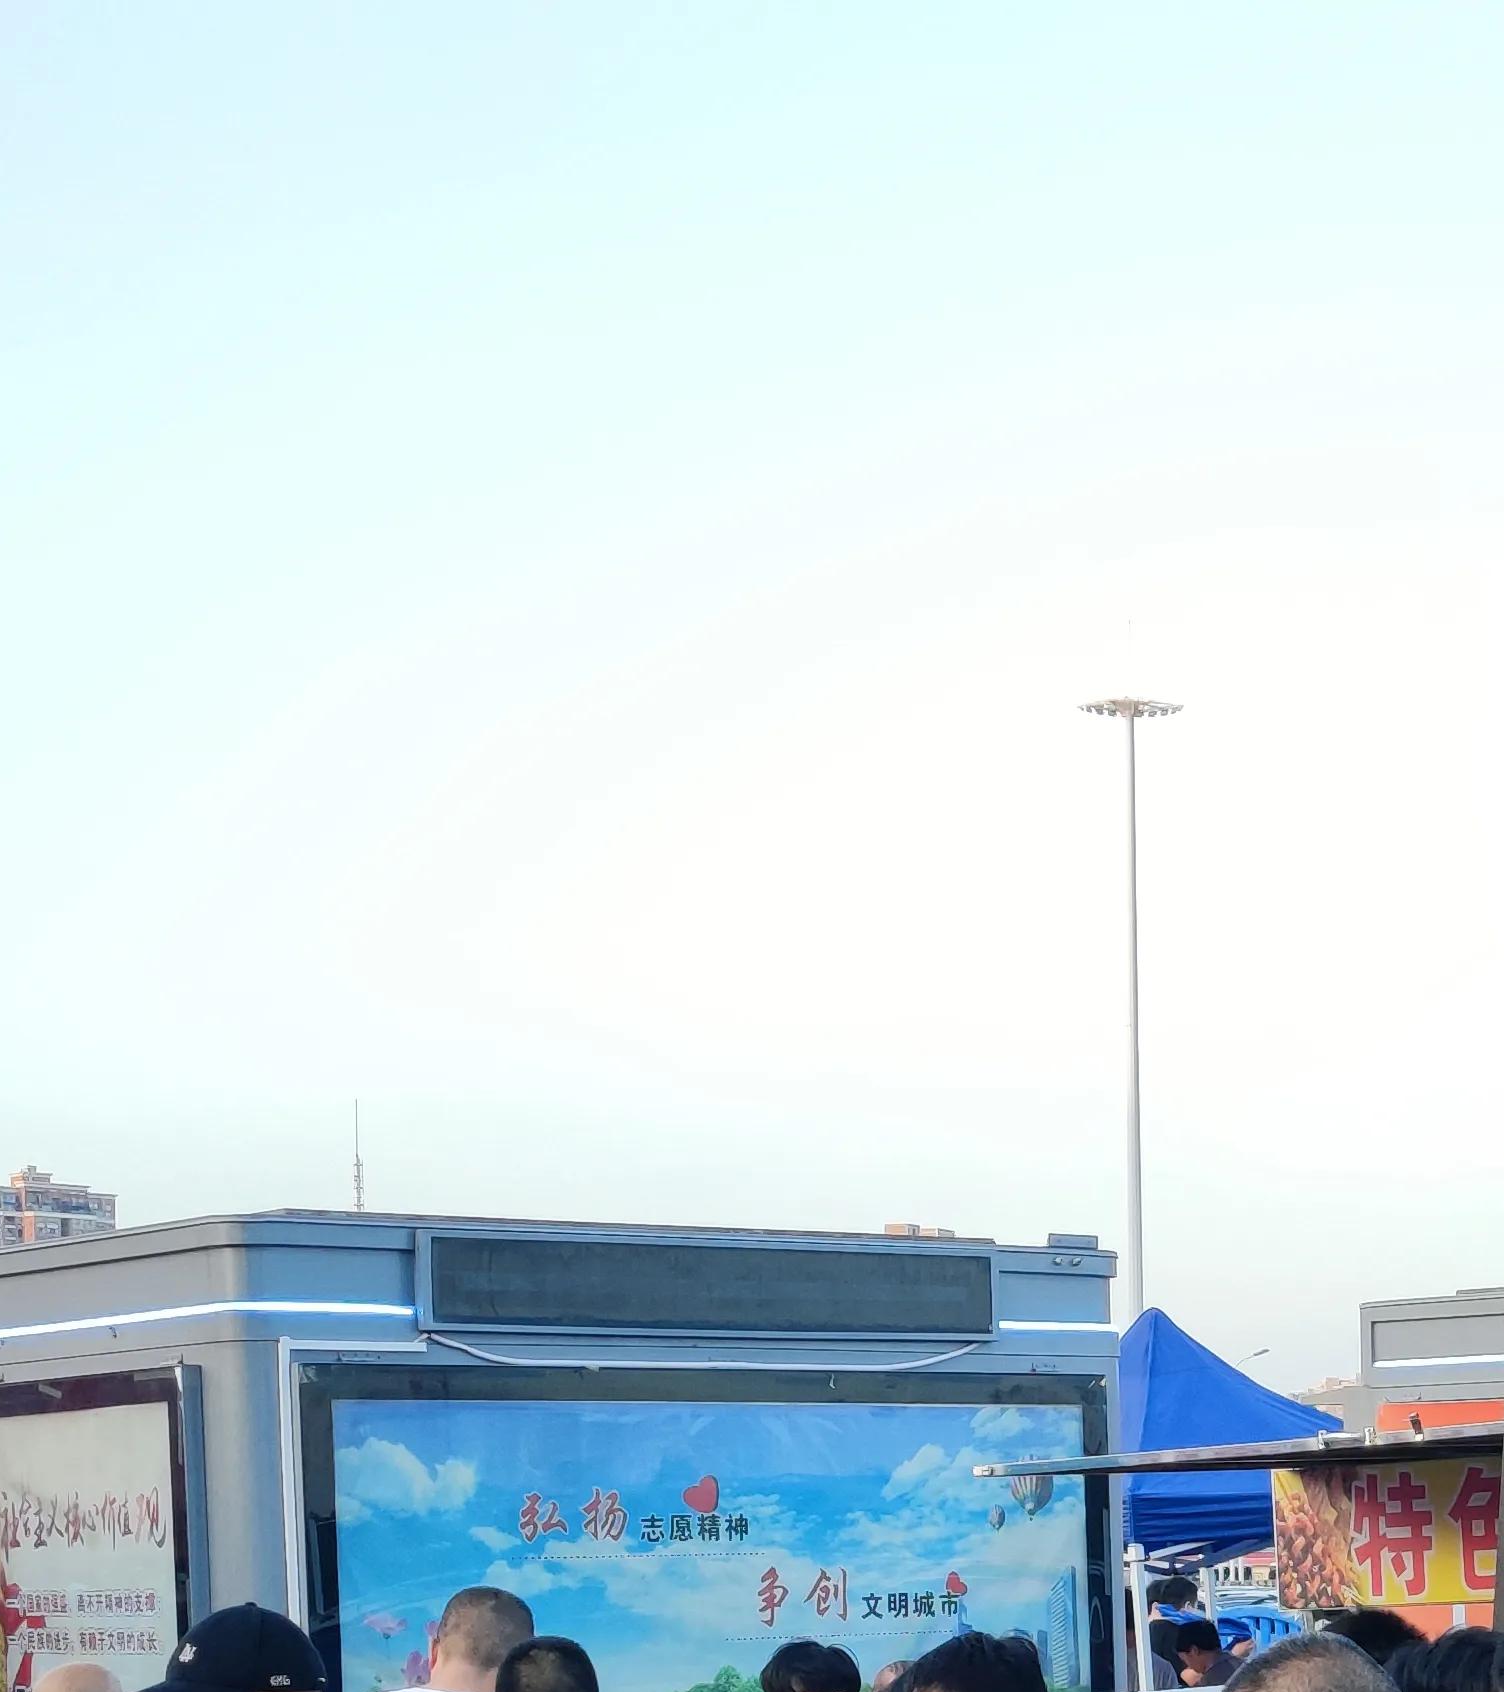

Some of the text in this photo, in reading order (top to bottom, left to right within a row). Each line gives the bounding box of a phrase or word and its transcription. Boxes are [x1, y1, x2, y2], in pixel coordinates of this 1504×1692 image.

[519, 1488, 750, 1544] 弘扬 志愿精神
[757, 1566, 959, 1628] 争创 文明城市
